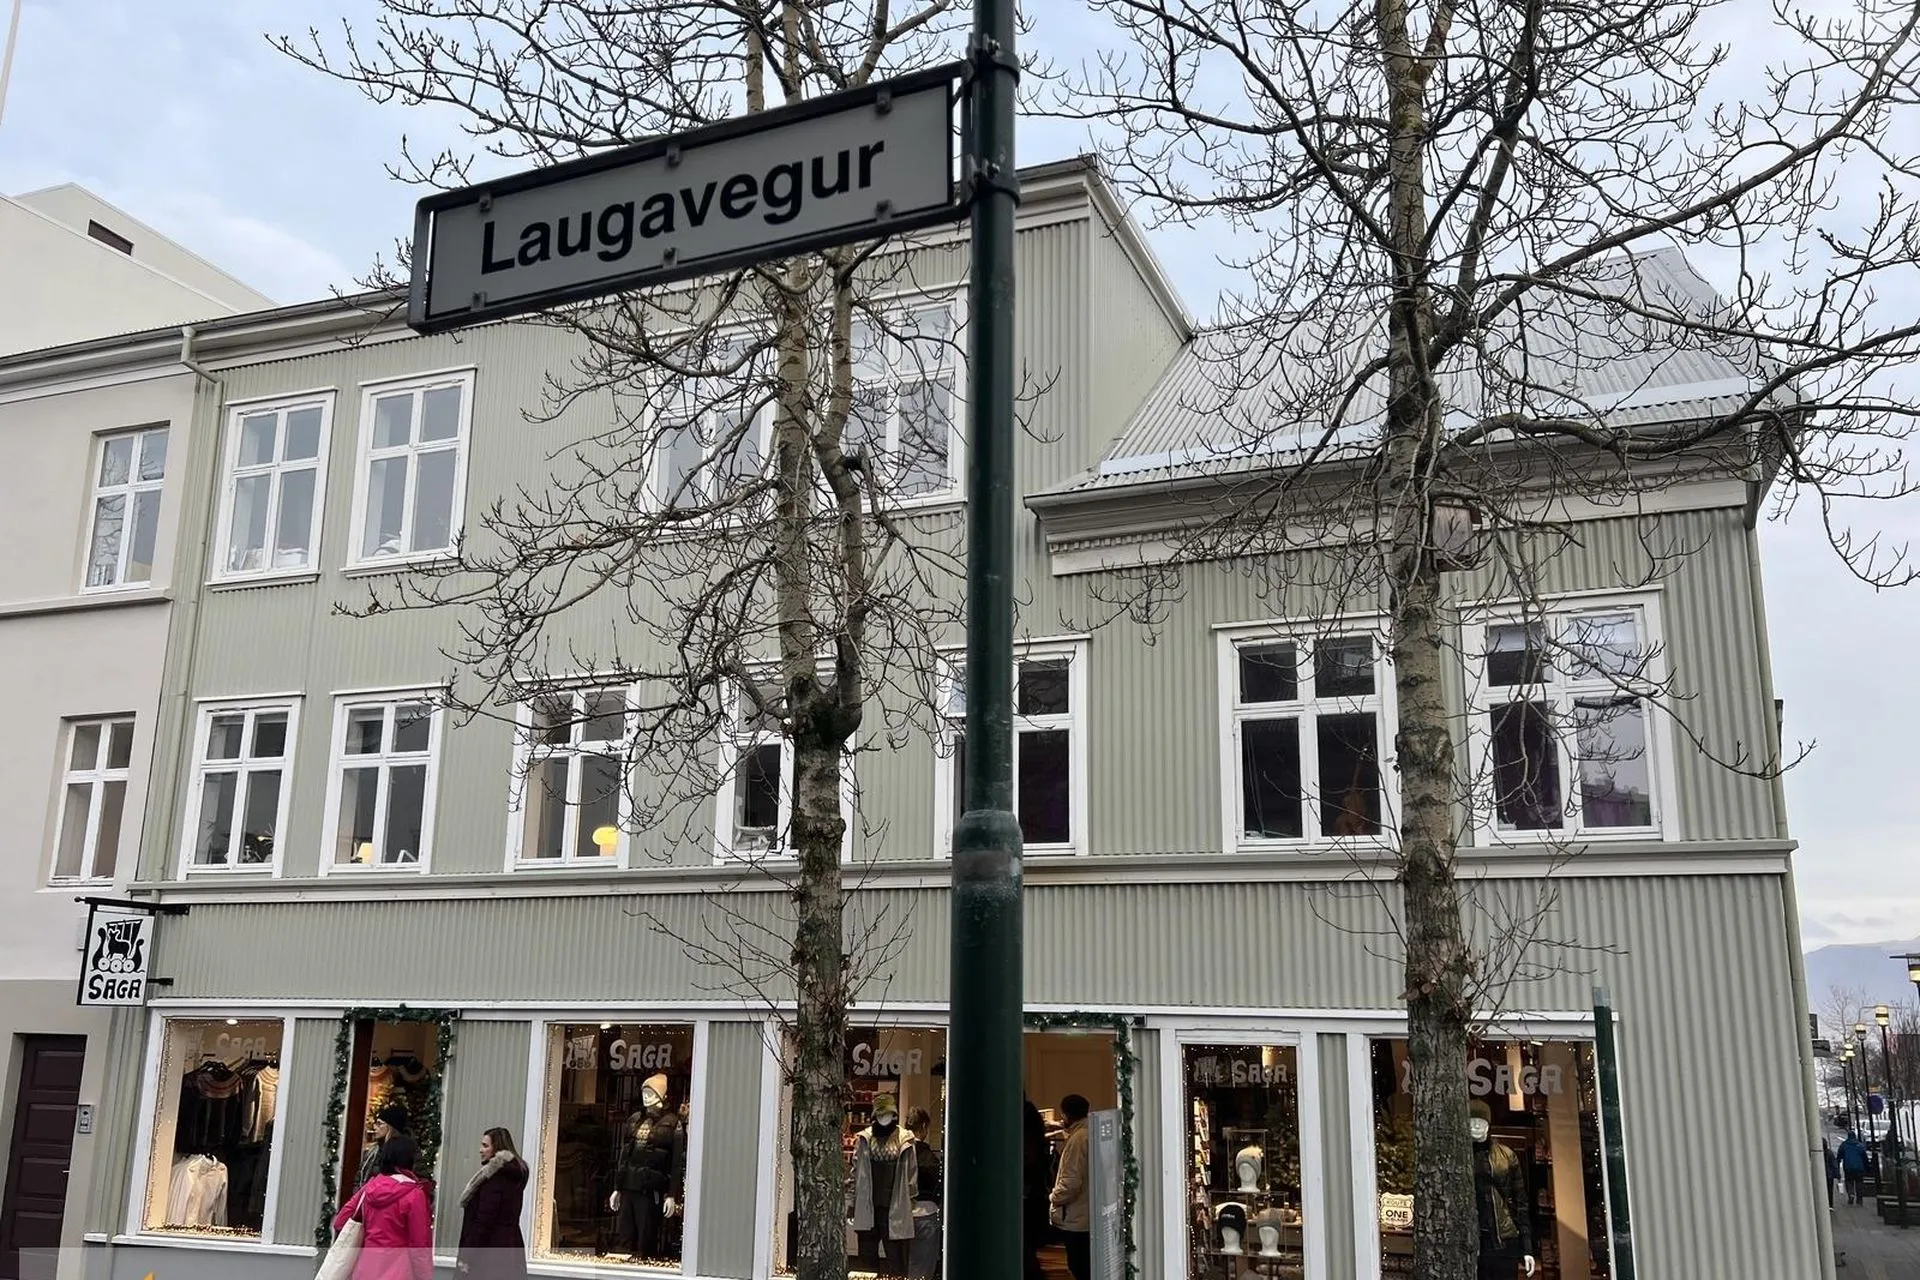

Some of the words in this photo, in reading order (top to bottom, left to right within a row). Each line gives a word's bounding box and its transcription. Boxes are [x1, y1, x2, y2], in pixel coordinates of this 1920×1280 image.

[480, 139, 885, 276] Laugavegur
[88, 973, 142, 1000] SAGA
[216, 1032, 267, 1060] SAGA
[609, 1039, 673, 1070] SAGA
[852, 1042, 922, 1076] SAGA
[1231, 1060, 1288, 1084] SAGA
[1466, 1058, 1564, 1096] SAGA
[1385, 1209, 1409, 1219] ONE
